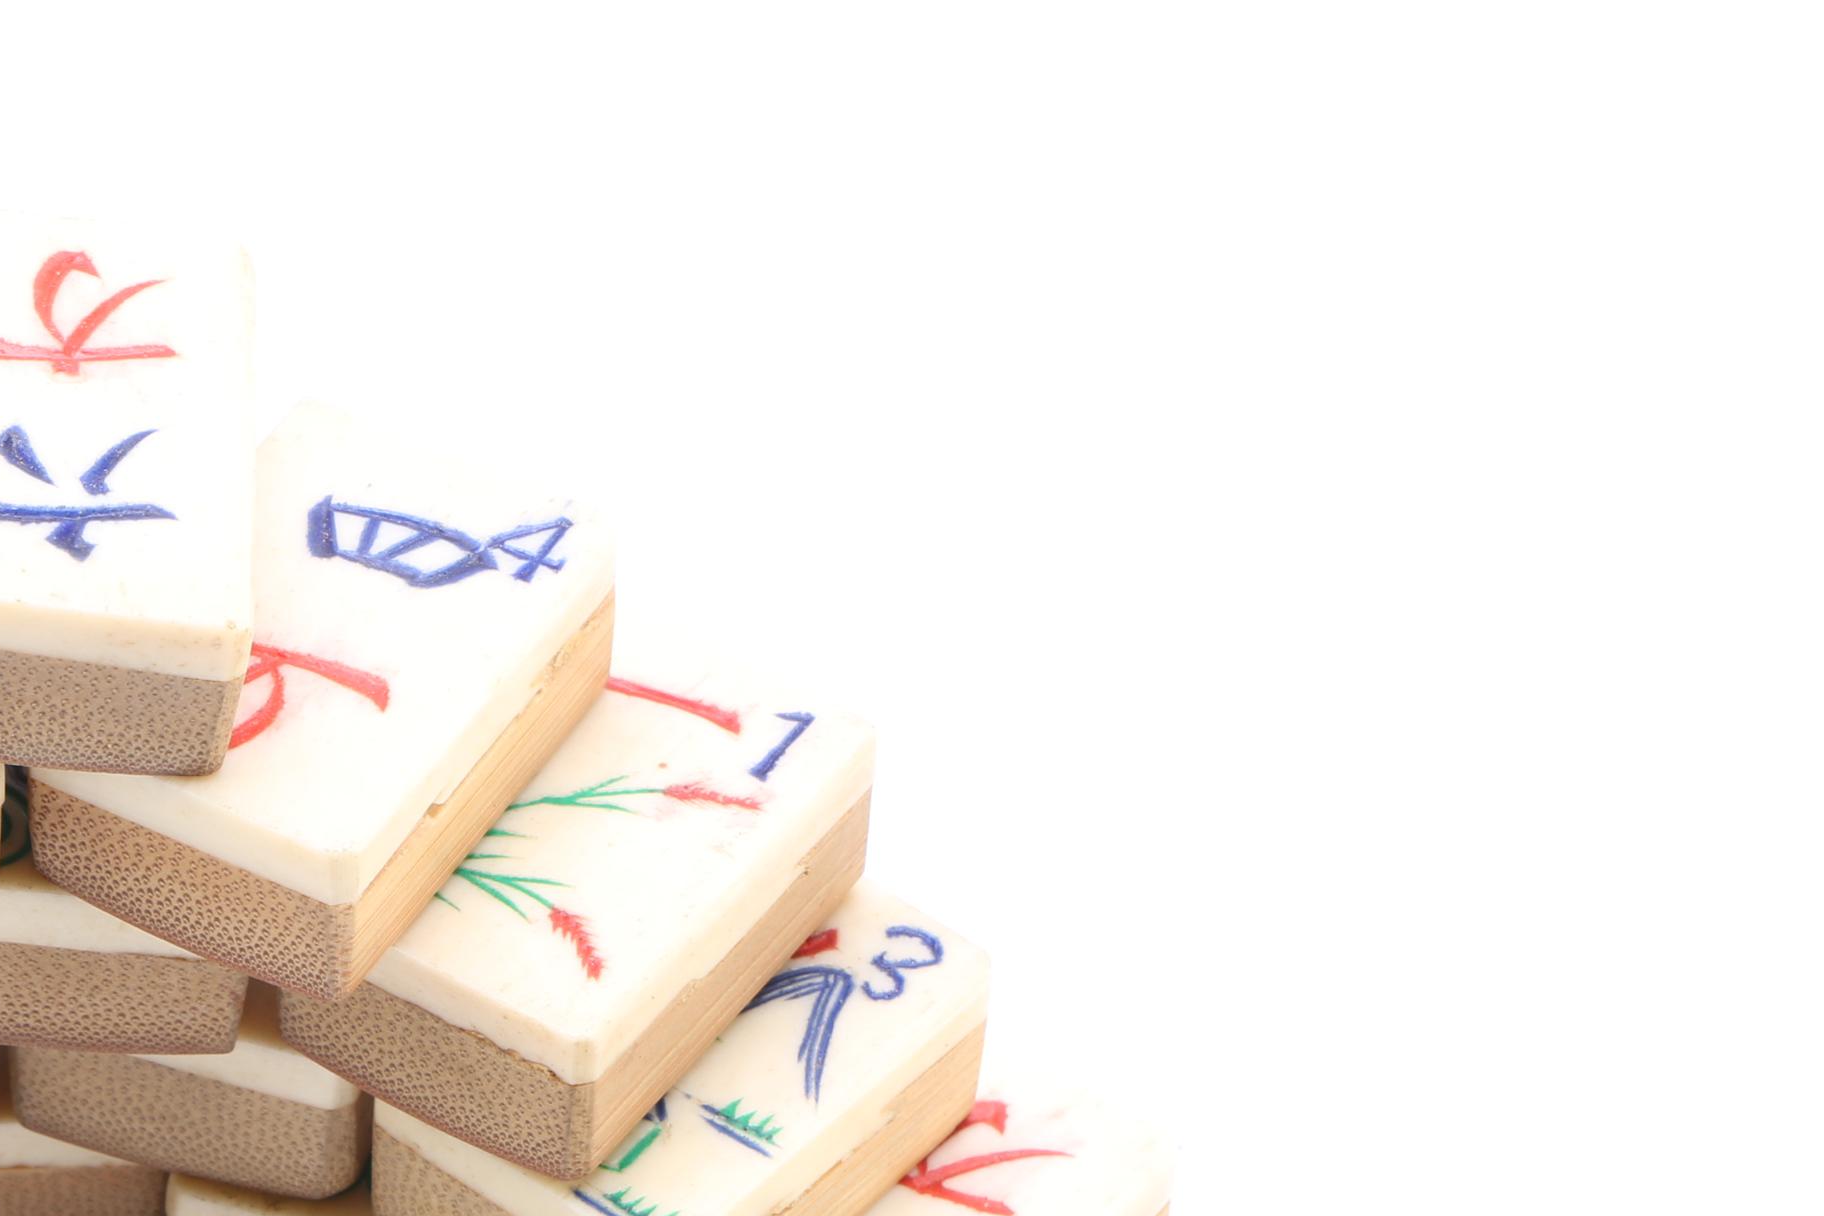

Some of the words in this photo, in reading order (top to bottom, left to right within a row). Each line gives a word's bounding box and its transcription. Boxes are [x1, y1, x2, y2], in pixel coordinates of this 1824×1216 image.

[474, 515, 575, 583] 4
[748, 710, 816, 783] 1
[860, 924, 945, 1002] 3
